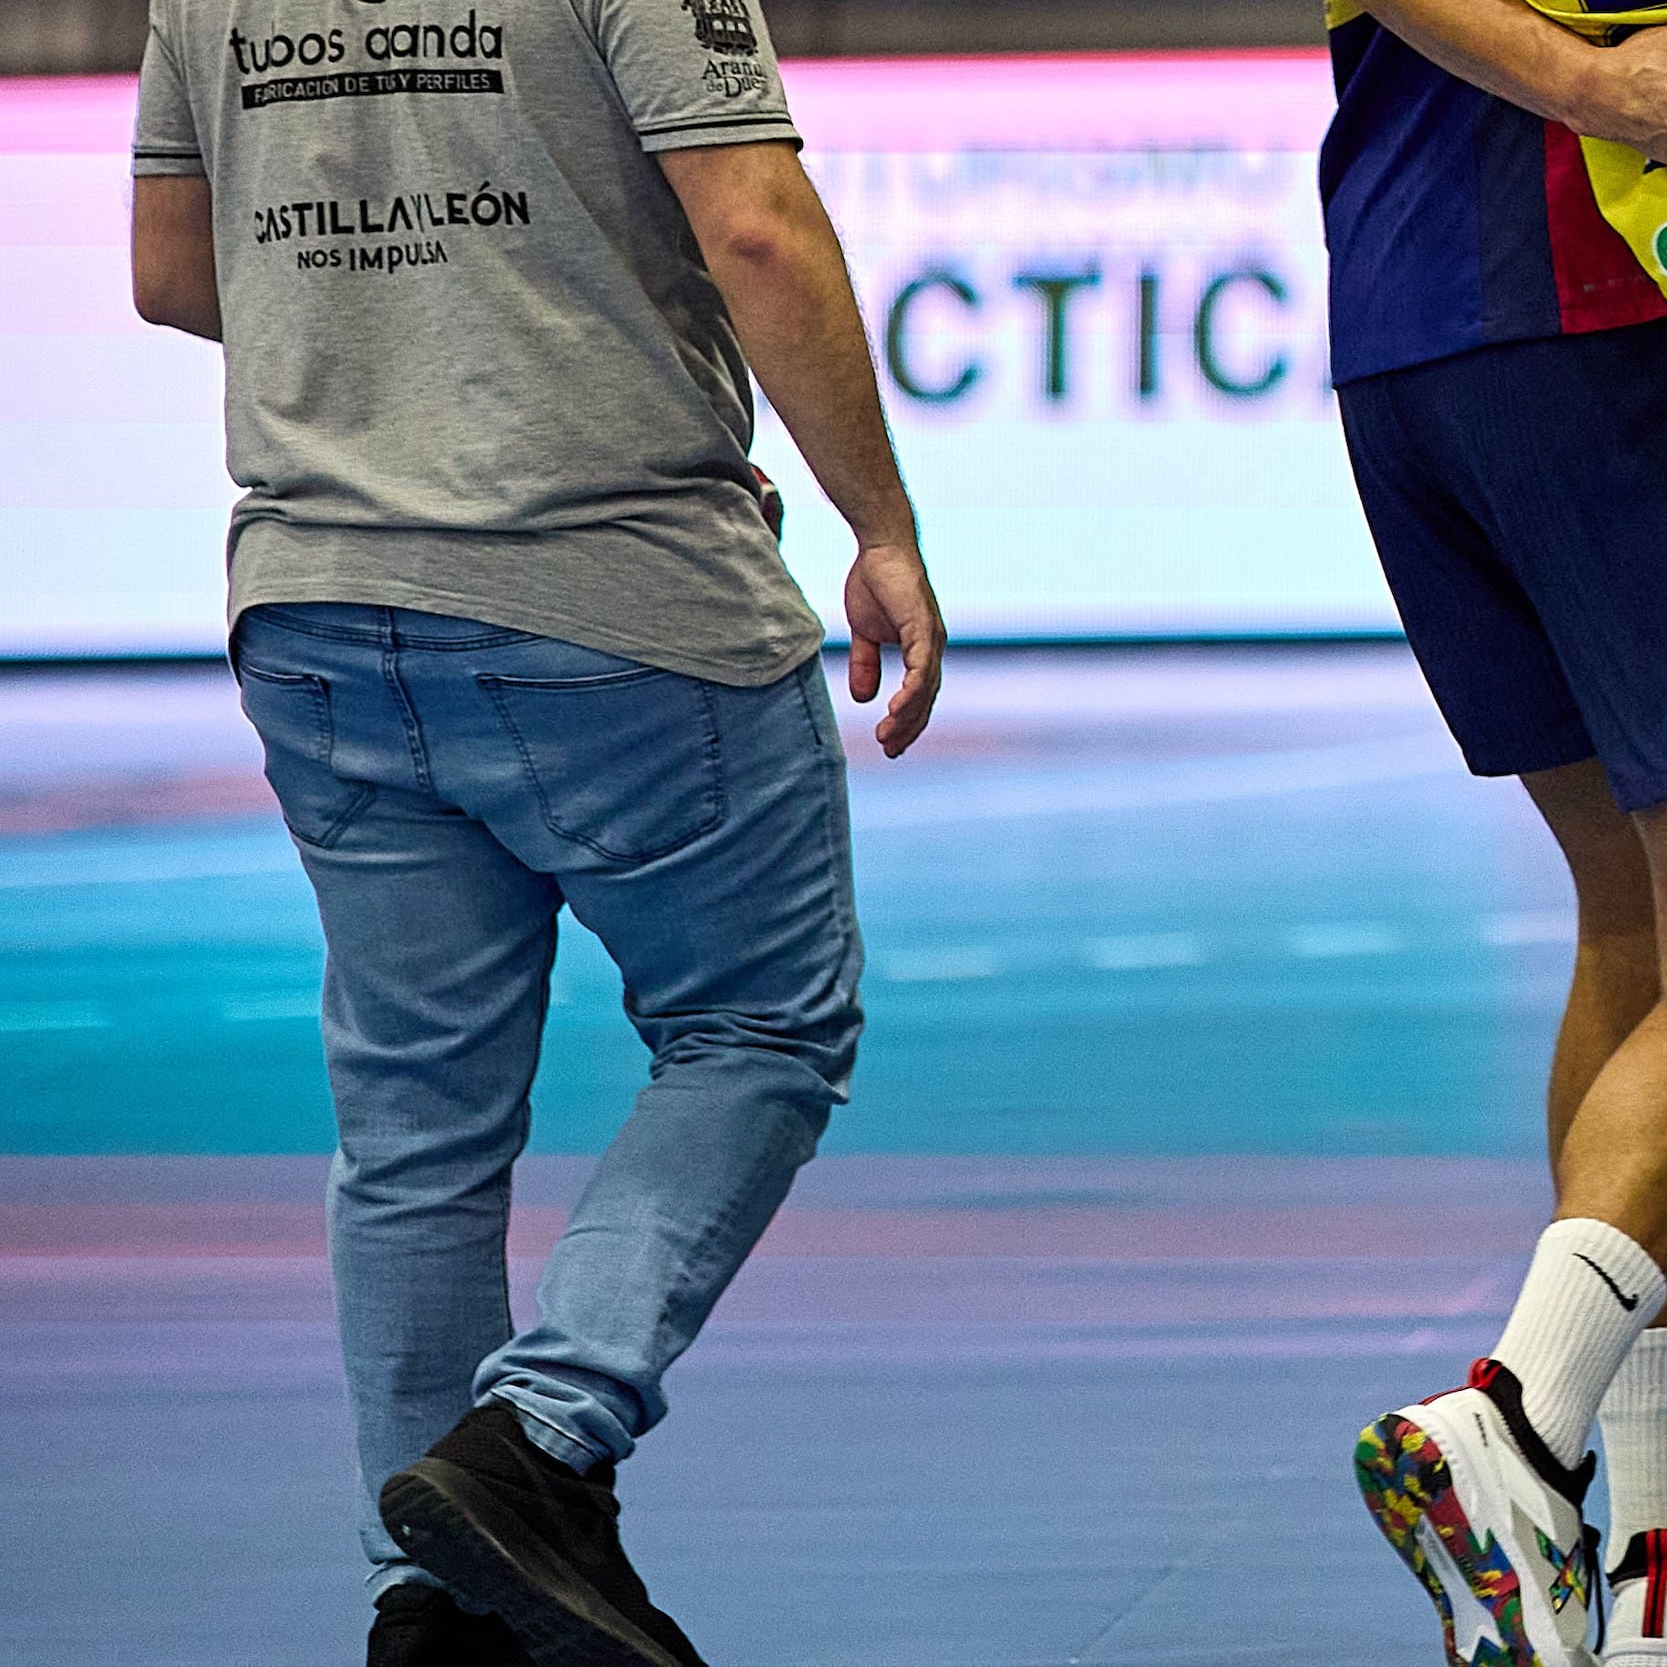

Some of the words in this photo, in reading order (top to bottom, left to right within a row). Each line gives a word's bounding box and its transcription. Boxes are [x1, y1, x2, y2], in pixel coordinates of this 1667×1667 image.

[344, 76, 370, 94] DE
[416, 73, 491, 91] PERFILES
[424, 180, 531, 227] LEÓN
[296, 249, 343, 270] NOS
[349, 240, 449, 275] IMPULSA
[884, 266, 1332, 404] CTIC
